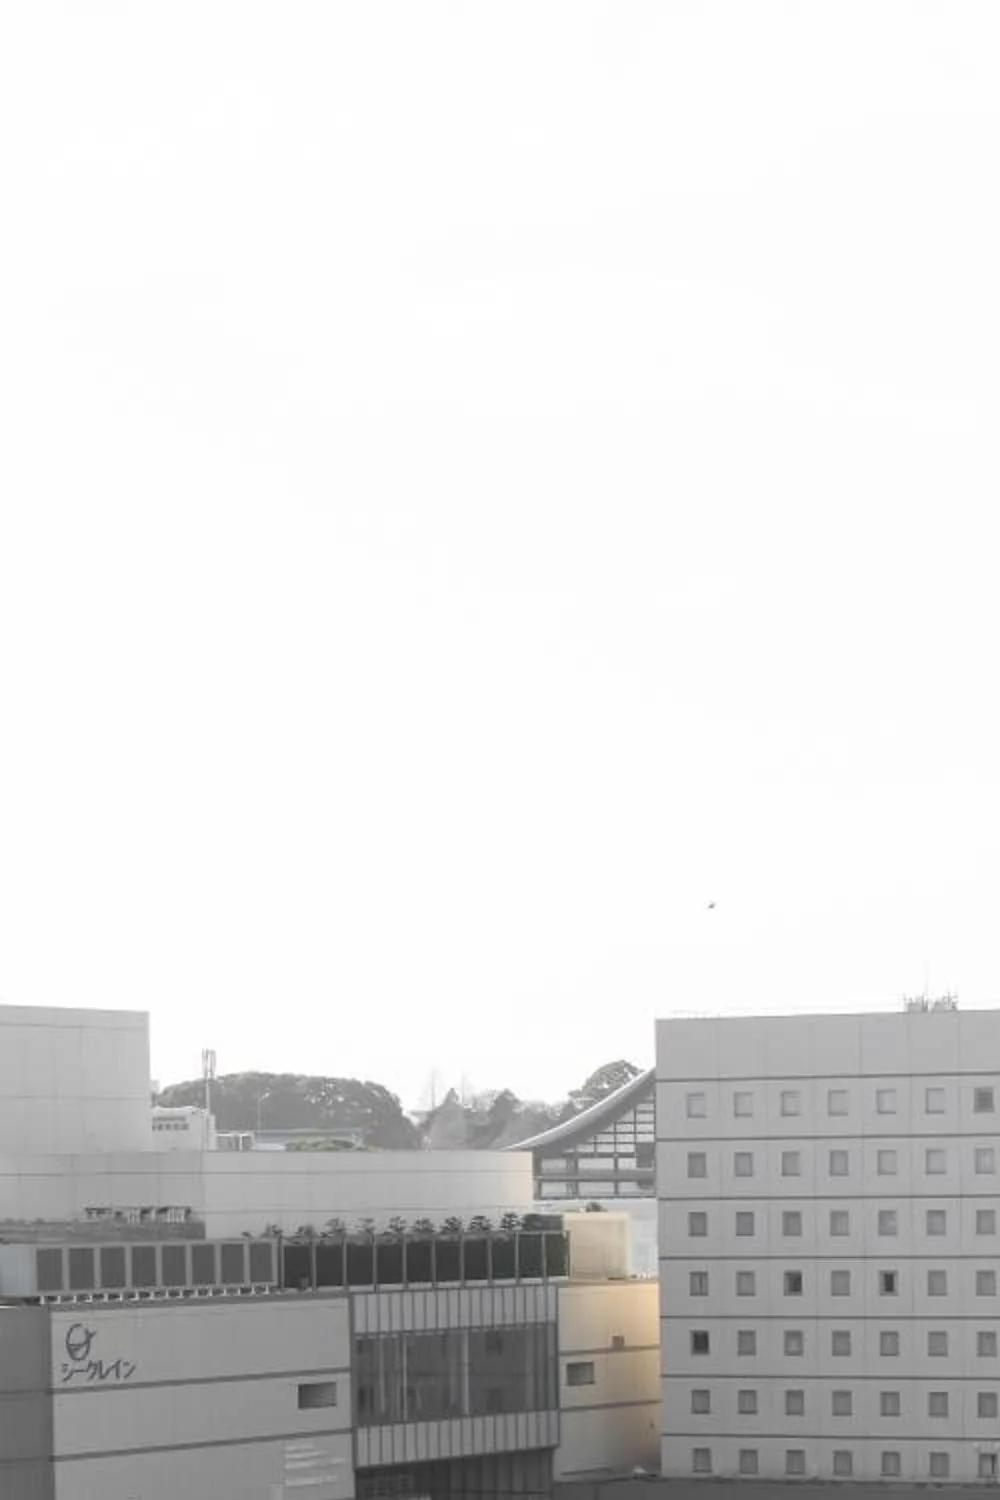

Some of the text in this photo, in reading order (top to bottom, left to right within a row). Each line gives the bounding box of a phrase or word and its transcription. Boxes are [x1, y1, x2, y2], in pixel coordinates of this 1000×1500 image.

[62, 1357, 135, 1381] シークレイン
